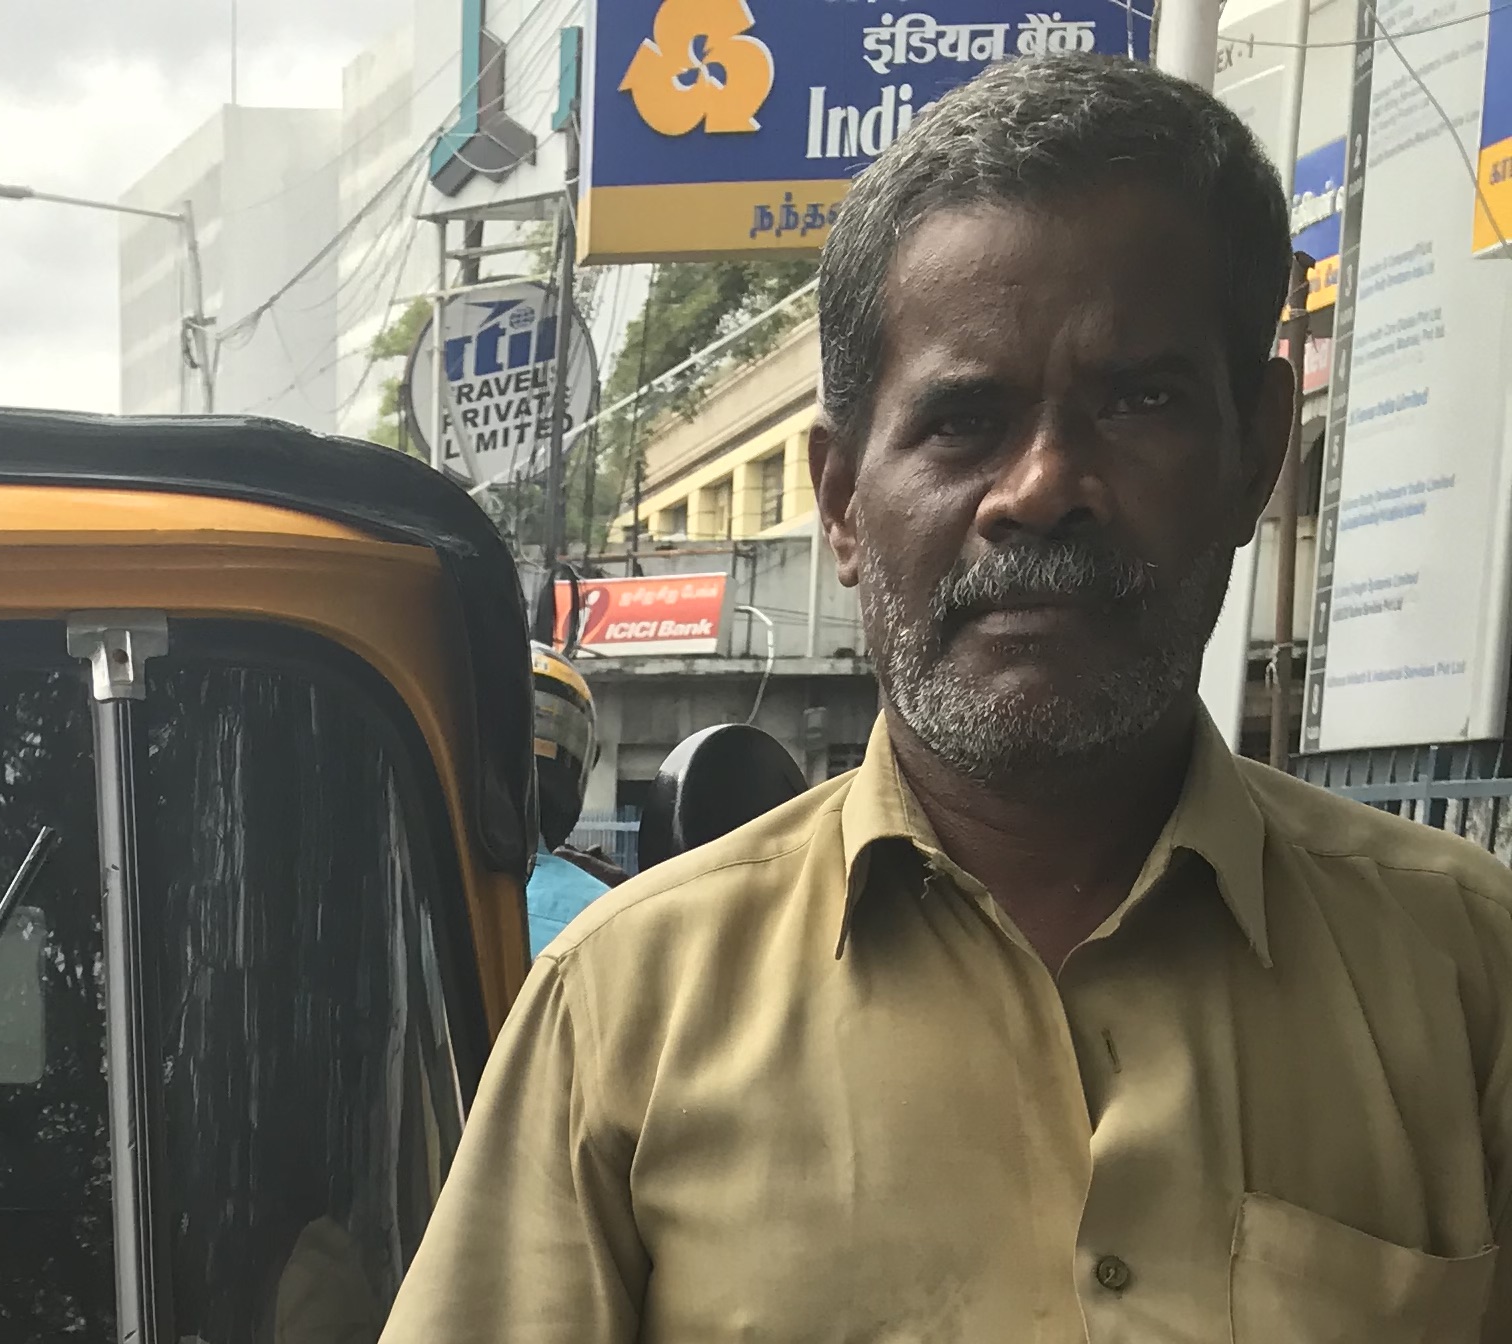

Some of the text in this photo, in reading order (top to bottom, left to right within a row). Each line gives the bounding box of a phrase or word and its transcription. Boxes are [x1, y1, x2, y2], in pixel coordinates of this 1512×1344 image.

[863, 12, 1096, 74] इंडियन बैंक
[450, 364, 558, 406] RAVEL
[604, 618, 713, 640] ICICI Bank
